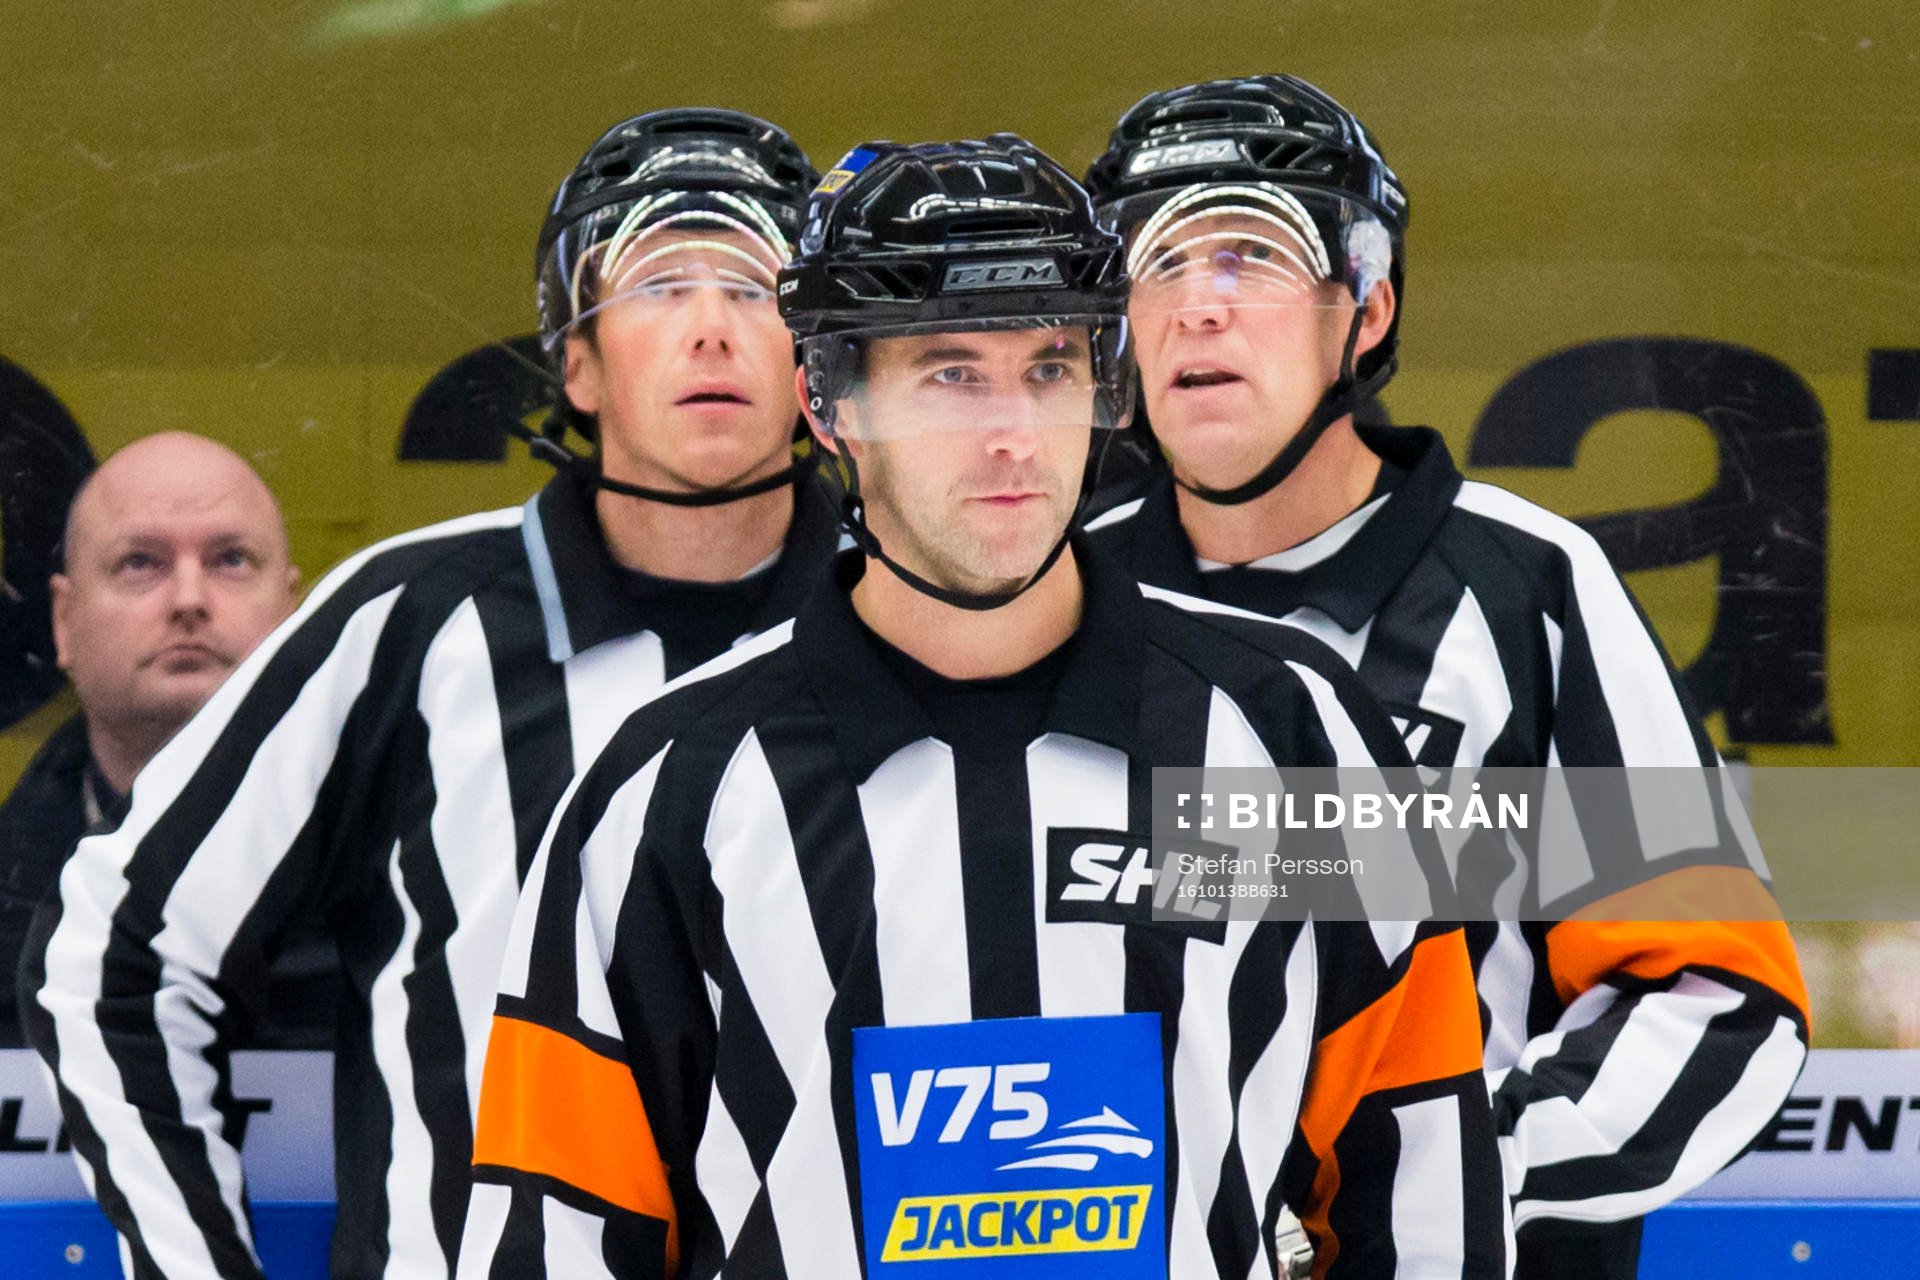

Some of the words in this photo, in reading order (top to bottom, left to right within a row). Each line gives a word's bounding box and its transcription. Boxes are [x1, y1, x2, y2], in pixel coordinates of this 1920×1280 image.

[948, 264, 1054, 285] CCM
[1059, 842, 1223, 920] SHL
[870, 1062, 1050, 1147] V75
[1752, 1096, 1920, 1152] EN
[900, 1194, 1139, 1252] JACKPOT
